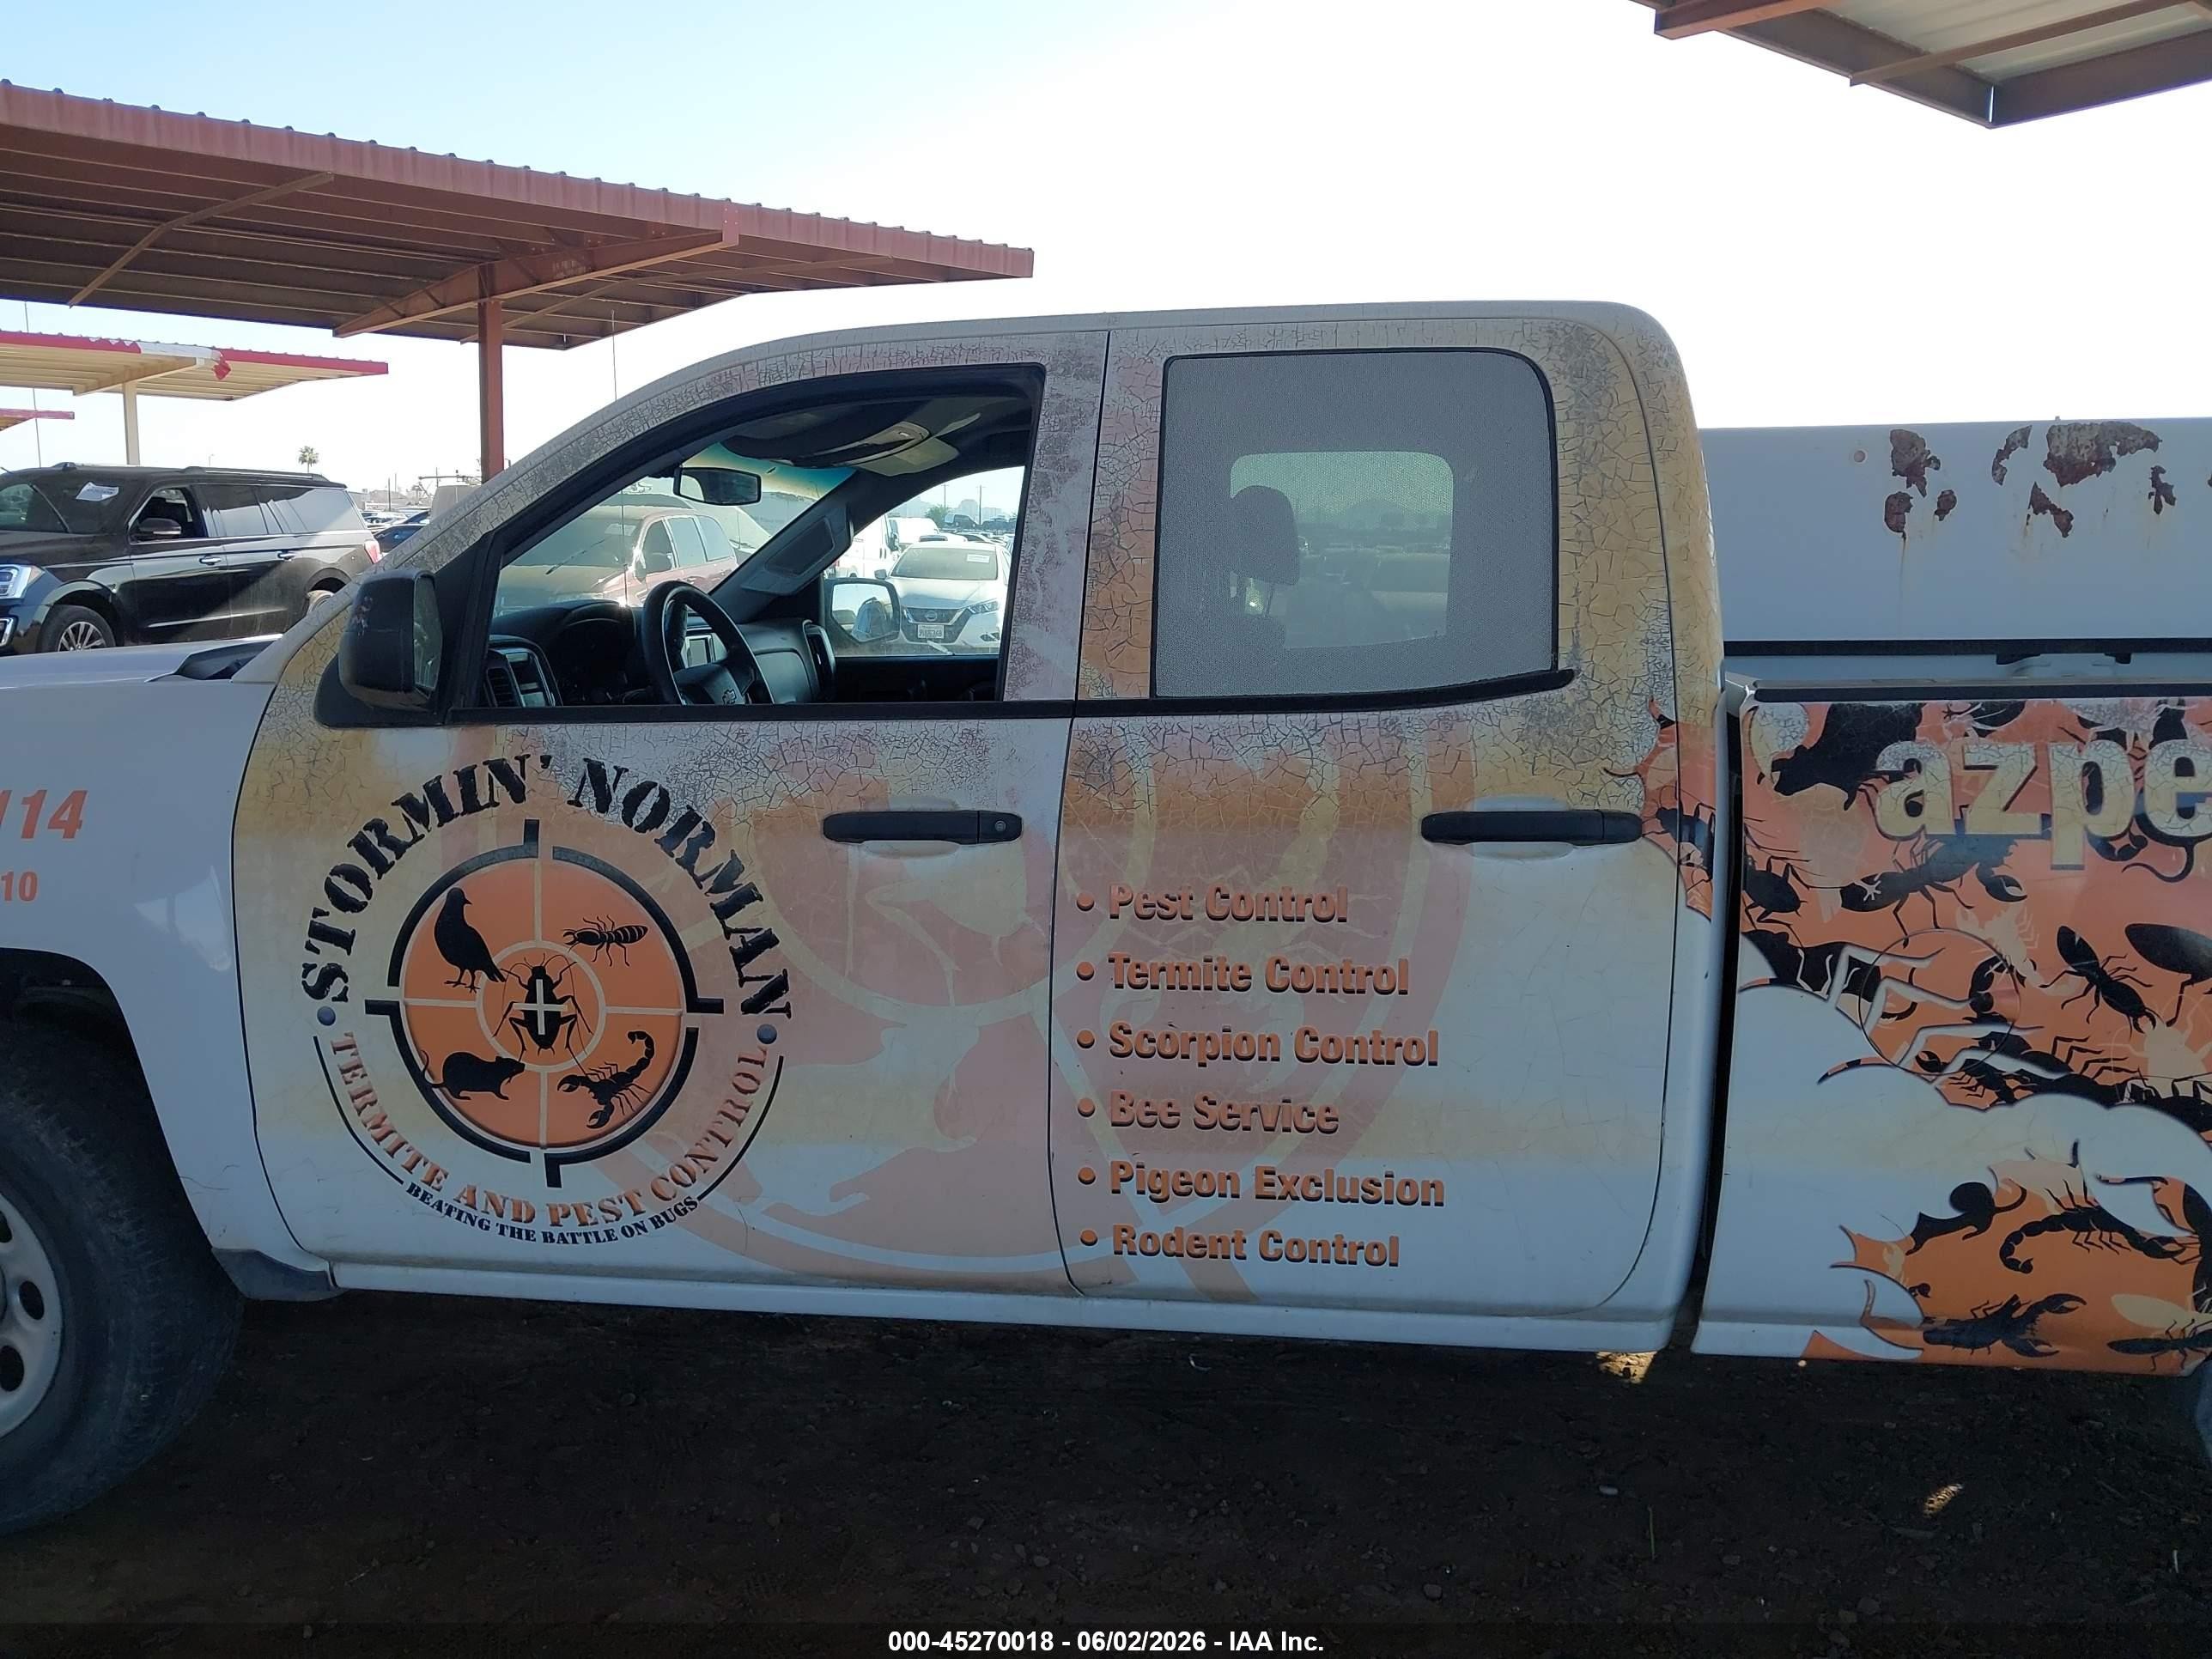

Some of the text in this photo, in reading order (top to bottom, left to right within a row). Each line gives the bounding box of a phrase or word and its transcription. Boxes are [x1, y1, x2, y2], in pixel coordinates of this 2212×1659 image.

[1875, 739, 2212, 870] azpe
[301, 754, 792, 1019] STORMIN' NORMAN
[1109, 884, 1348, 922] Pest Control
[1108, 952, 1409, 995] Termite Control
[1109, 1020, 1439, 1067] Scorpion Control
[331, 1031, 768, 1227] TERMITE AND PEST CONTROL
[1110, 1090, 1340, 1133] Bee Service
[1110, 1160, 1445, 1207] Pigeon Exclusion
[405, 1182, 698, 1244] BEATING THE BATTLE ON BUGS
[1113, 1224, 1400, 1267] Rodent Control
